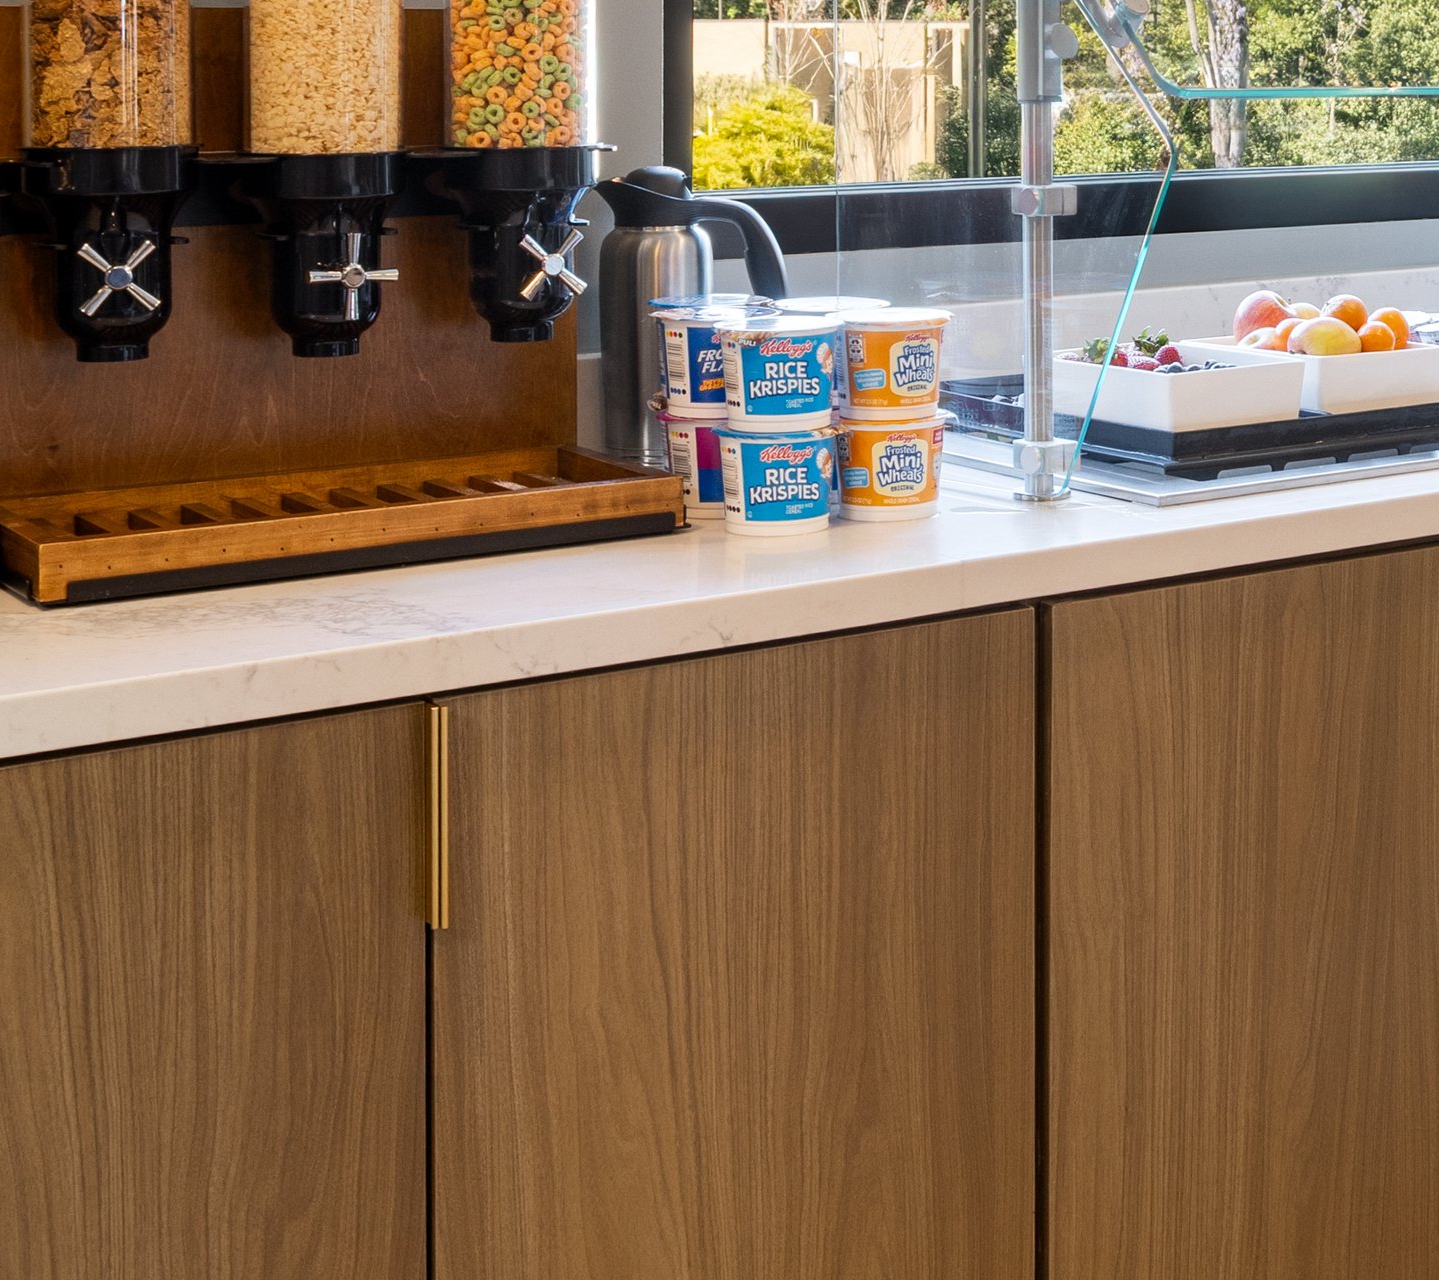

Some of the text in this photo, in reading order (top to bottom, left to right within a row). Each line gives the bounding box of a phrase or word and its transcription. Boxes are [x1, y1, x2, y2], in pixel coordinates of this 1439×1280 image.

[760, 339, 813, 358] Kellogg's
[904, 344, 931, 355] Frosted
[765, 362, 807, 379] RICE
[899, 353, 933, 372] Mini
[895, 369, 933, 386] Wheats
[749, 378, 820, 398] KRISPIES
[760, 444, 814, 464] Kellogg's
[886, 445, 916, 456] Frosted
[880, 452, 922, 473] Mini
[764, 467, 808, 485] RICE
[877, 469, 922, 487] Wheats
[749, 483, 820, 504] KRISPIES
